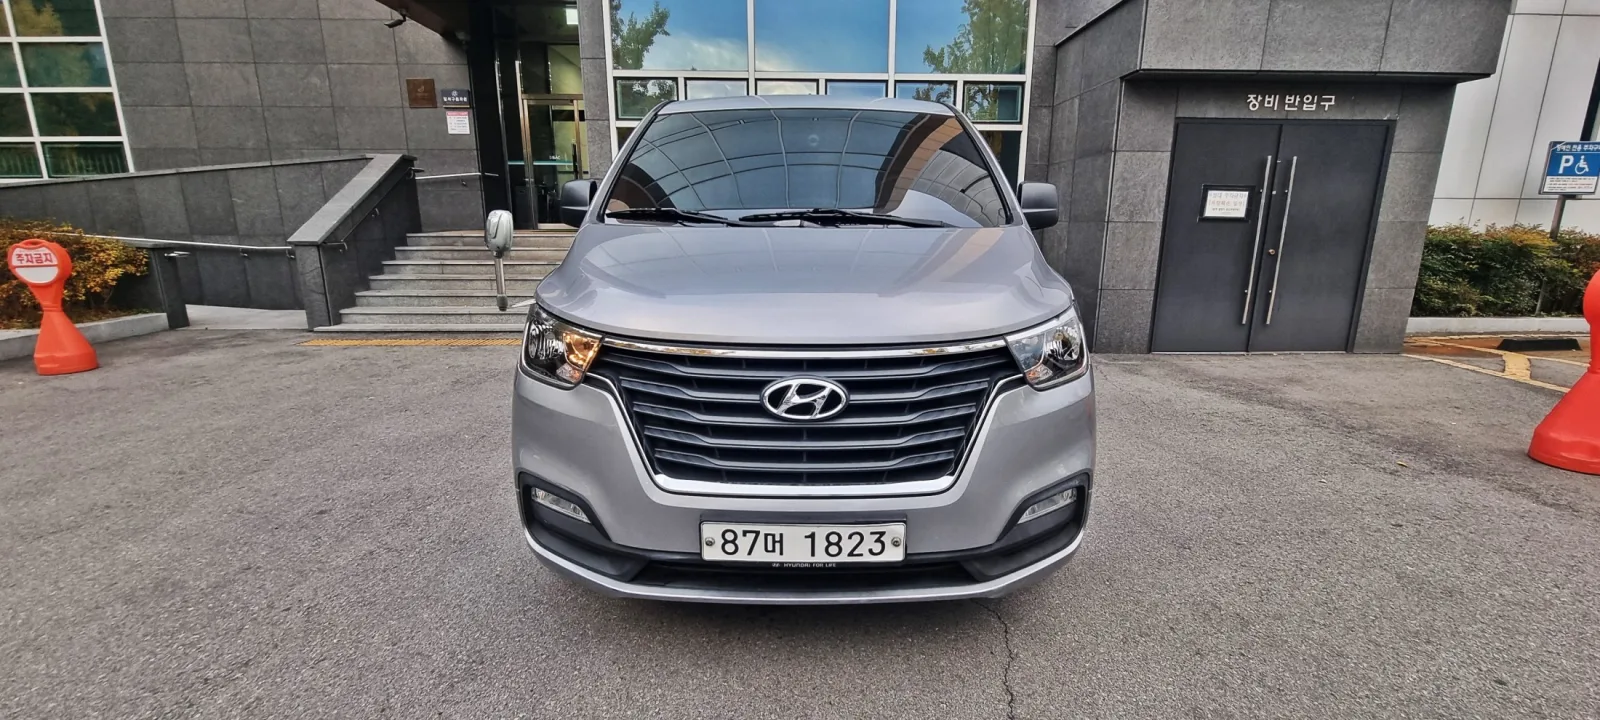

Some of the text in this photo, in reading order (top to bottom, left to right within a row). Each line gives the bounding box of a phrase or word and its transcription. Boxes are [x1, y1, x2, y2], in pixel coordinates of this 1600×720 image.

[1246, 94, 1336, 111] 장비 반입구
[1558, 155, 1575, 174] P
[720, 528, 886, 557] 87머 1823
